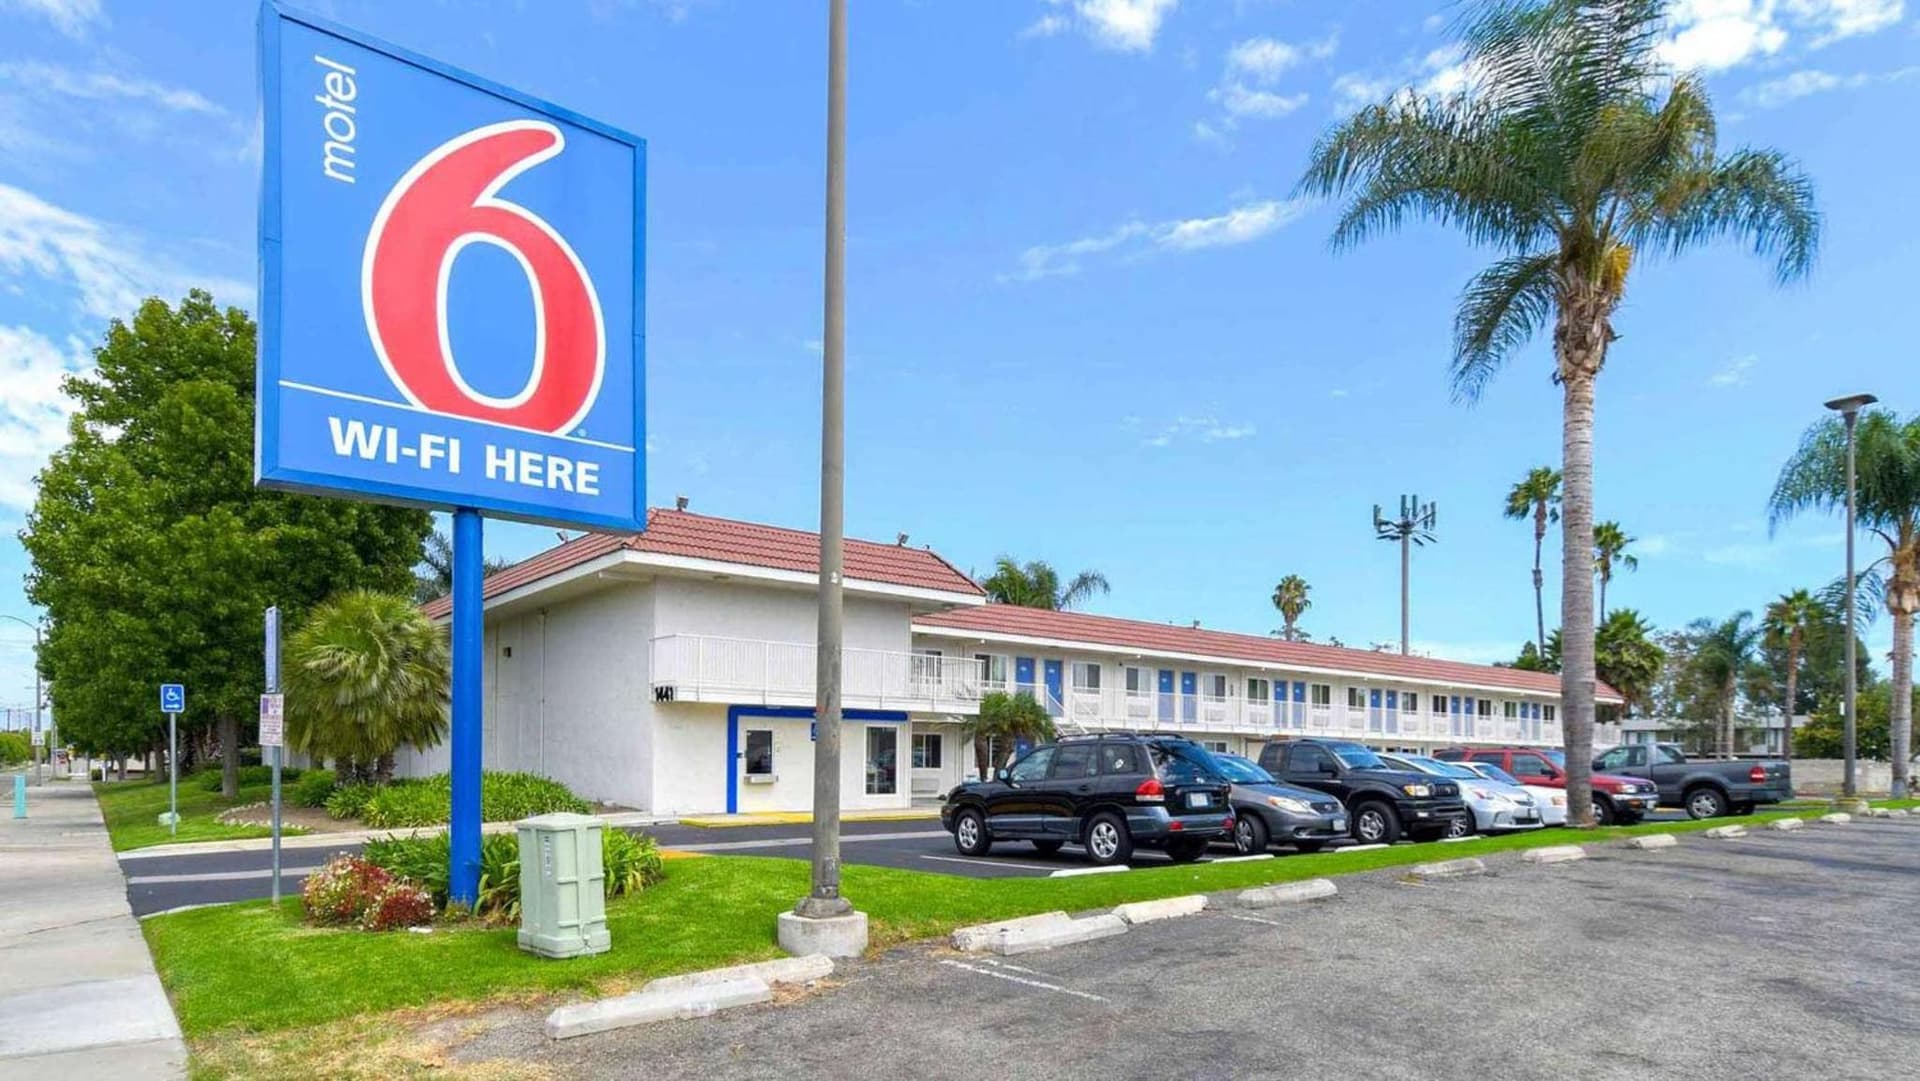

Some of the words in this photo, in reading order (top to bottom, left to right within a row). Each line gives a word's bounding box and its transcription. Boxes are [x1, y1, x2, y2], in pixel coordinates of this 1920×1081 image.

[315, 56, 357, 183] motel
[361, 119, 606, 436] 6
[328, 416, 461, 473] WI-FI
[485, 444, 599, 496] HERE
